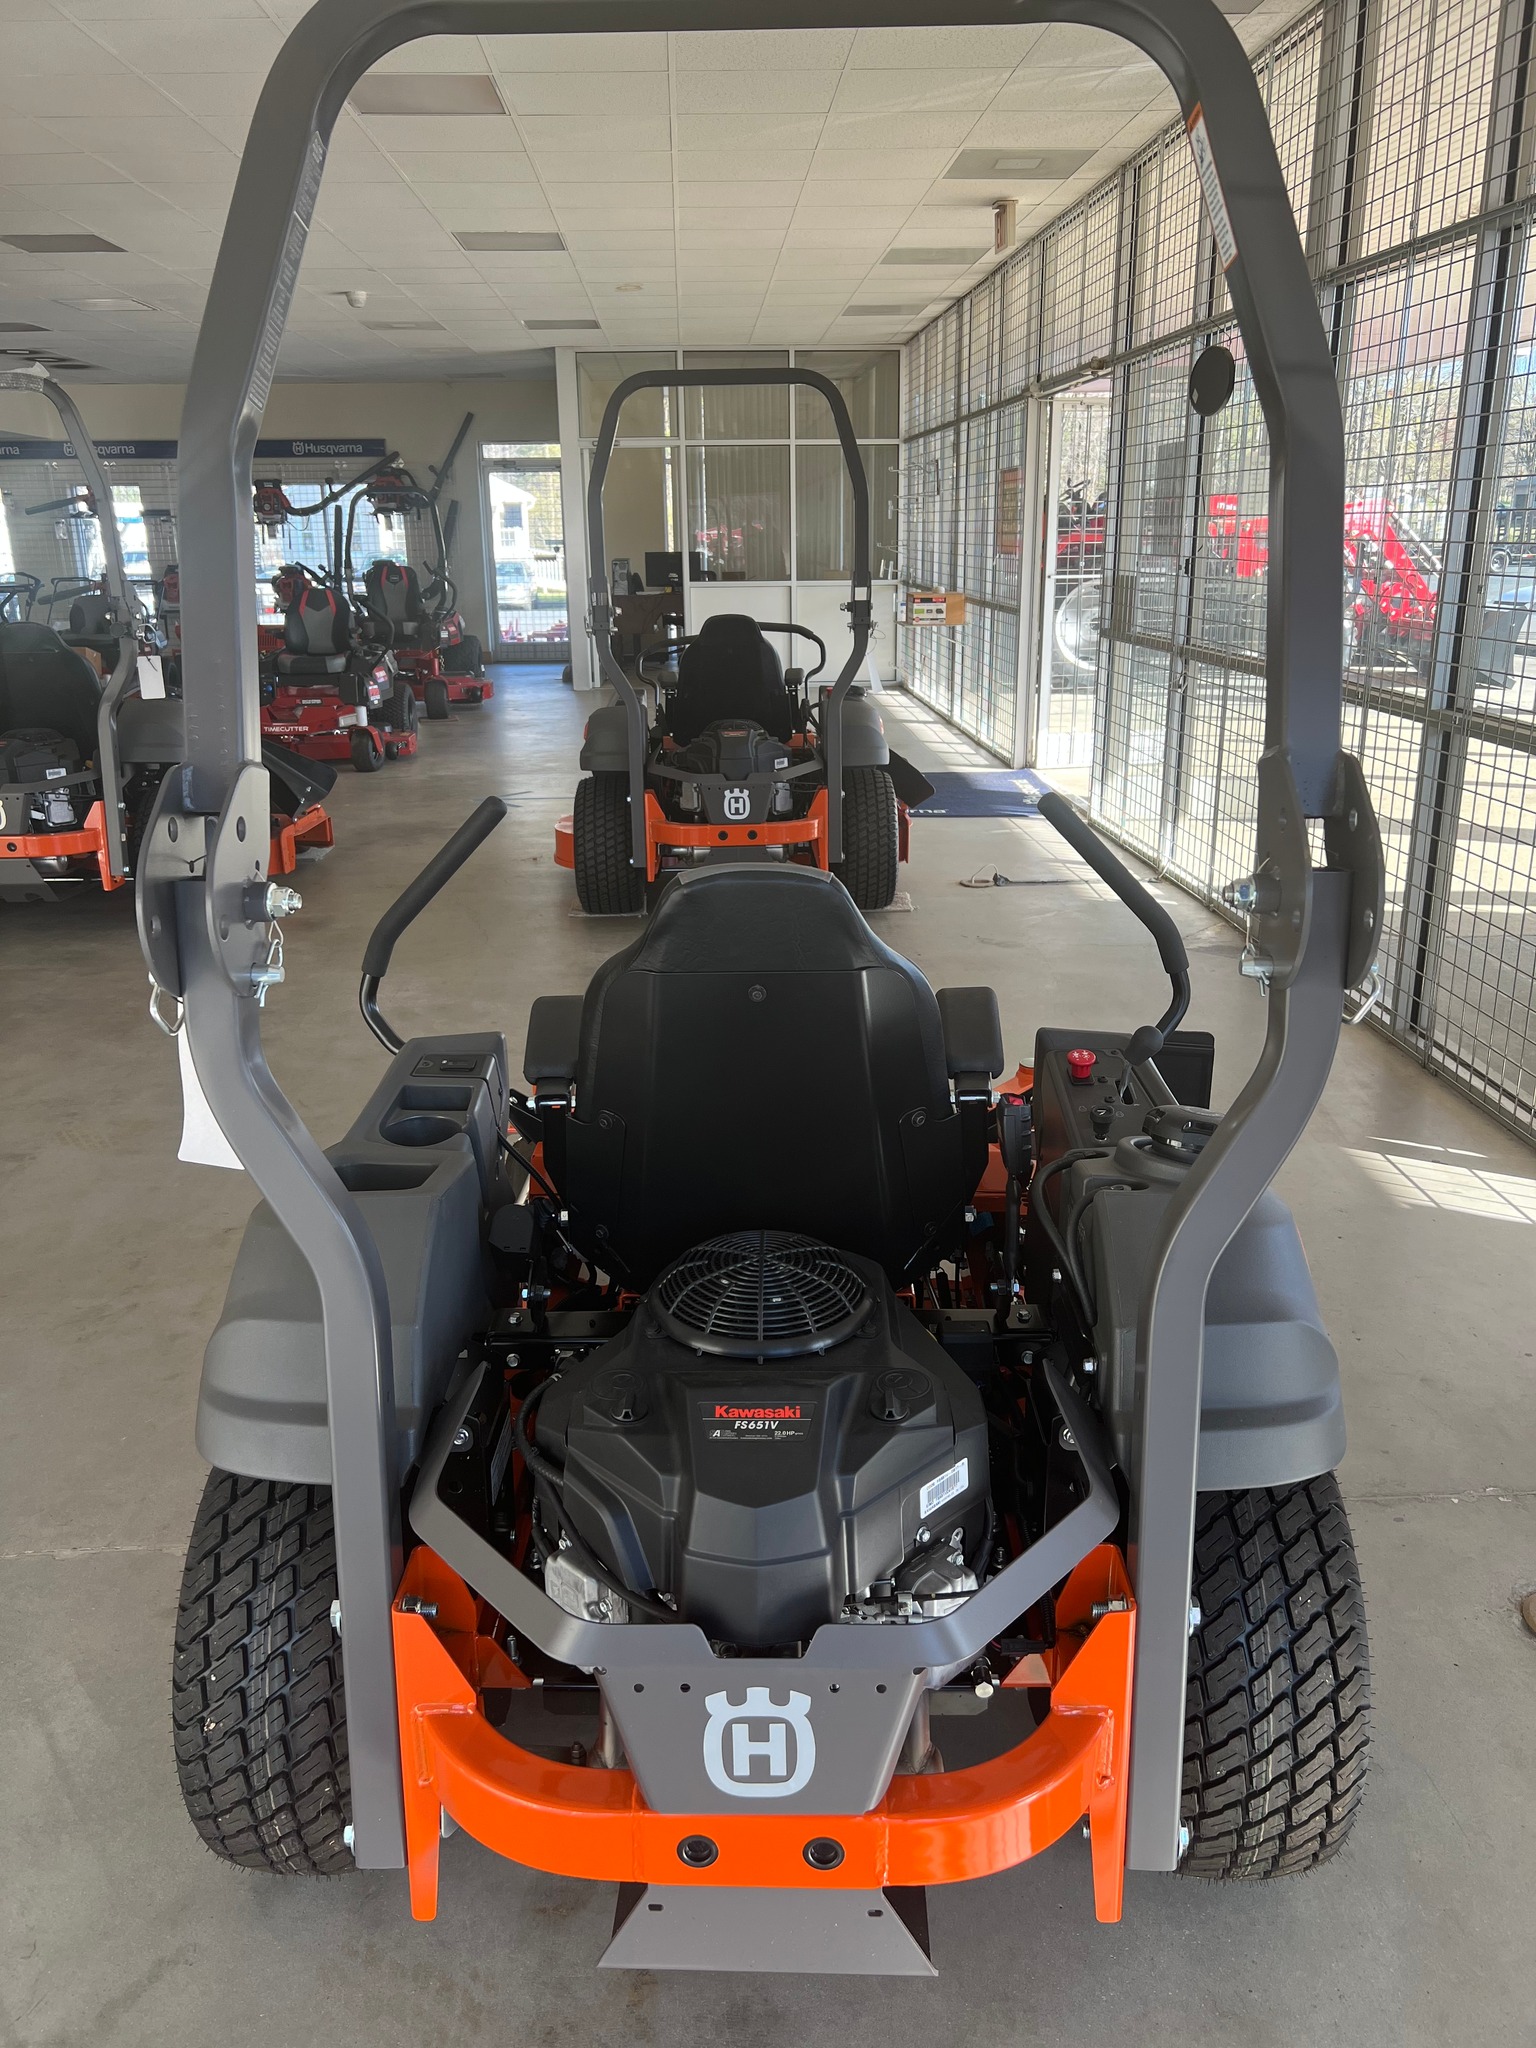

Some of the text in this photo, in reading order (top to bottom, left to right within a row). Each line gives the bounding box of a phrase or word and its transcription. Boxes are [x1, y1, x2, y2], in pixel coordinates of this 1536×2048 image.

[305, 443, 363, 455] Husqvarna
[715, 1405, 800, 1418] Kawasaki
[734, 1420, 779, 1430] FS651V
